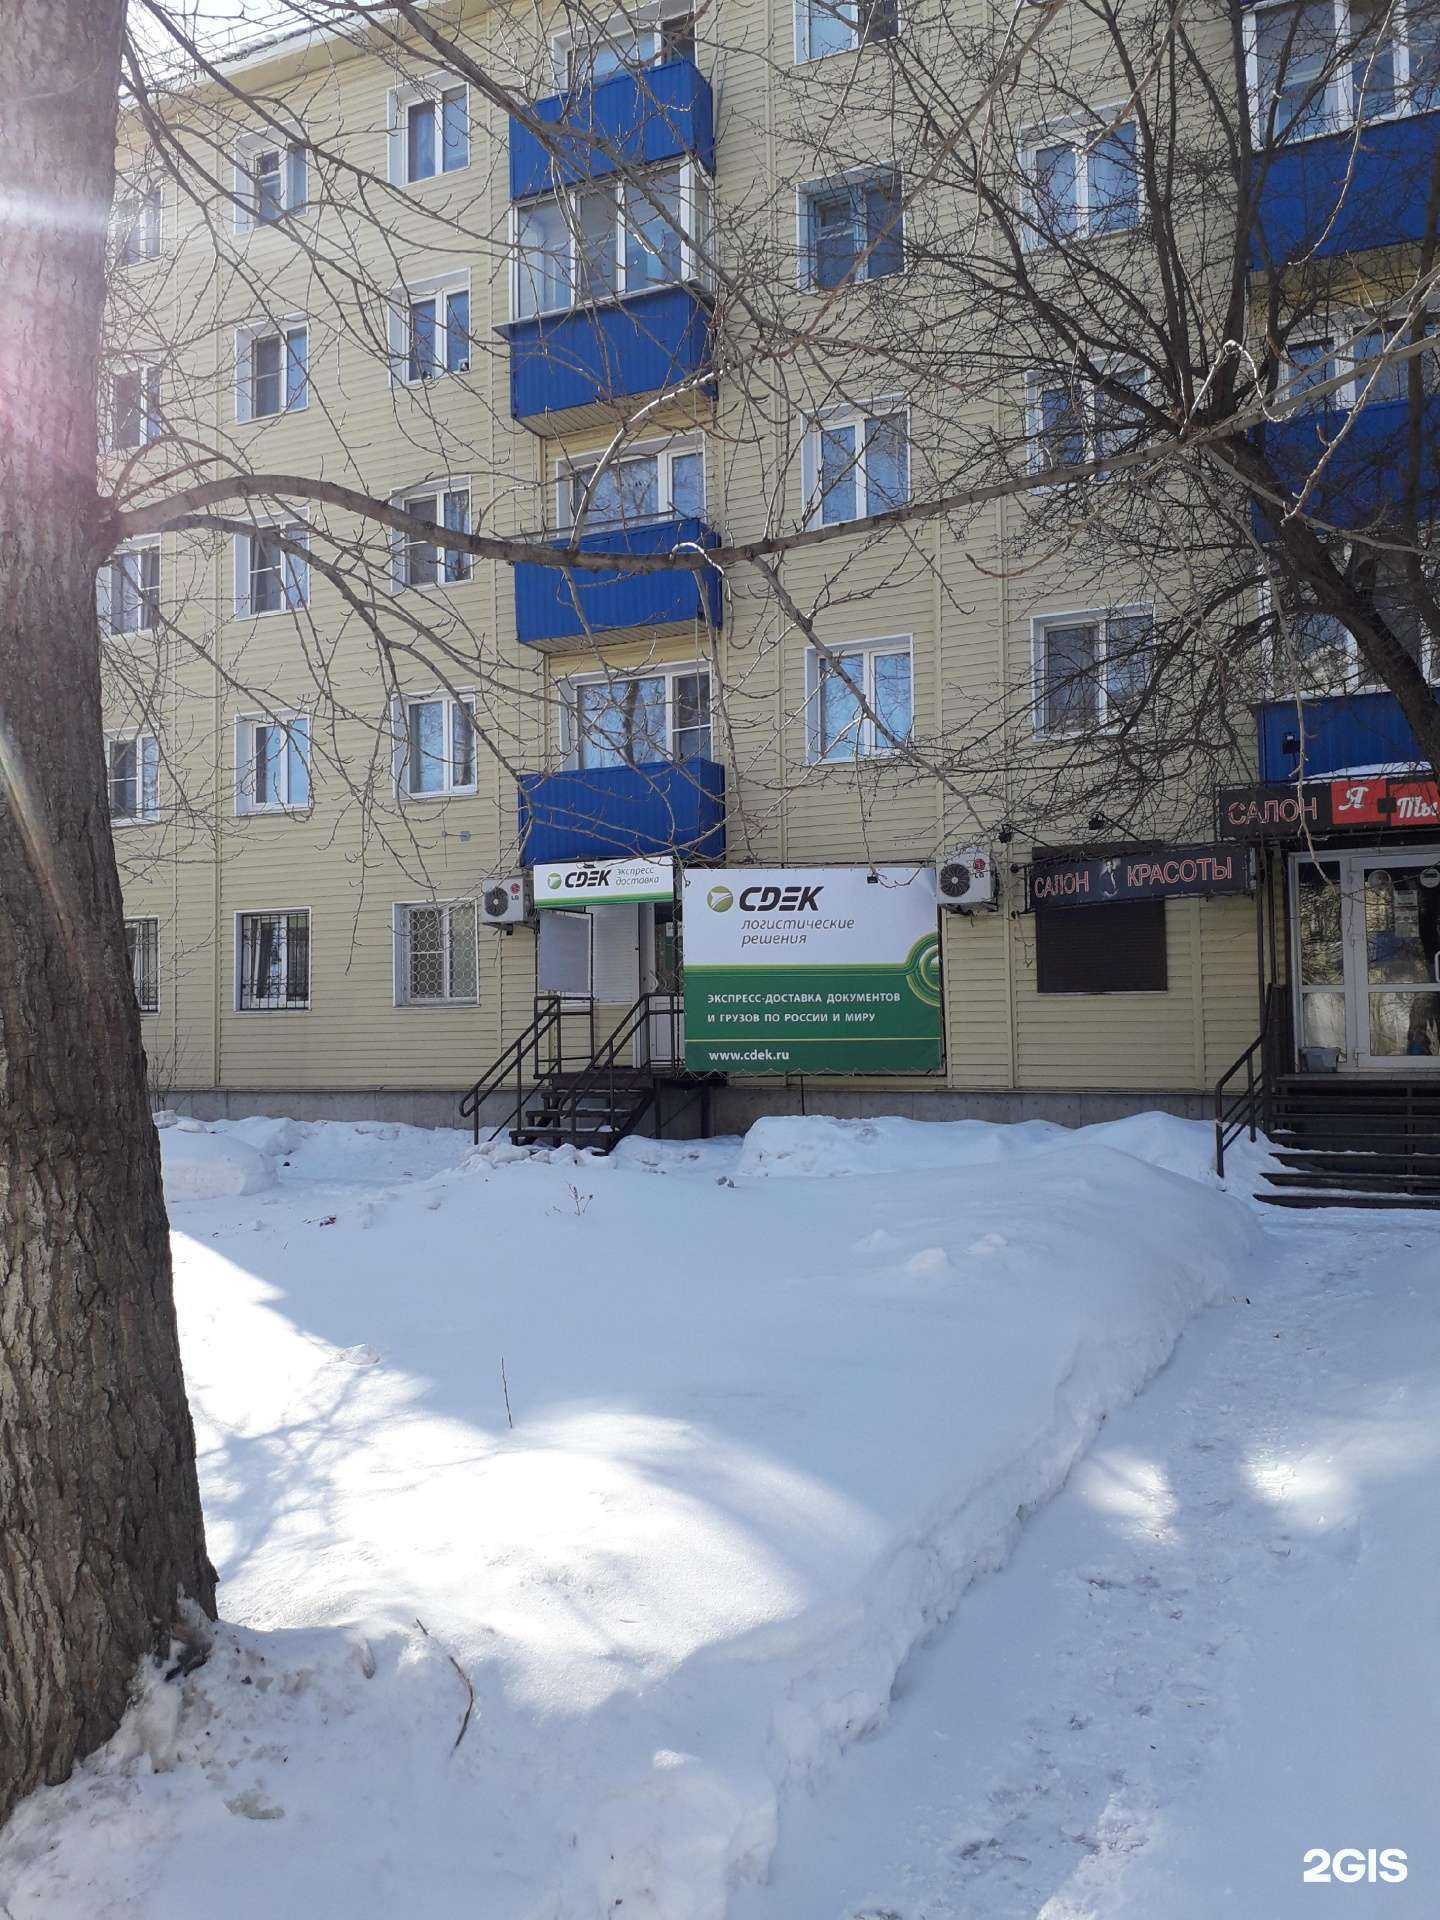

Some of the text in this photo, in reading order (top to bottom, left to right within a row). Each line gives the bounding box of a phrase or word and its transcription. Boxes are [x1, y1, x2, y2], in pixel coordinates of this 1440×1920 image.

[1338, 786, 1369, 811] Я
[1227, 797, 1318, 825] САЛОН
[616, 867, 654, 876] экспресс
[1034, 856, 1232, 898] САЛОН КРАСОТЫ
[564, 869, 612, 888] CDEK
[615, 874, 660, 886] доставка
[739, 886, 825, 912] CDEK
[741, 918, 855, 930] логистические
[741, 933, 808, 947] решения
[707, 993, 901, 1004] ЭКСПРЕСС-ДОСТАВКА ДОКУМЕНТОВ
[707, 1013, 875, 1023] И ГРУЗОВ ПО РОССИИ И МИРУ
[709, 1049, 790, 1061] www.cdek.ru
